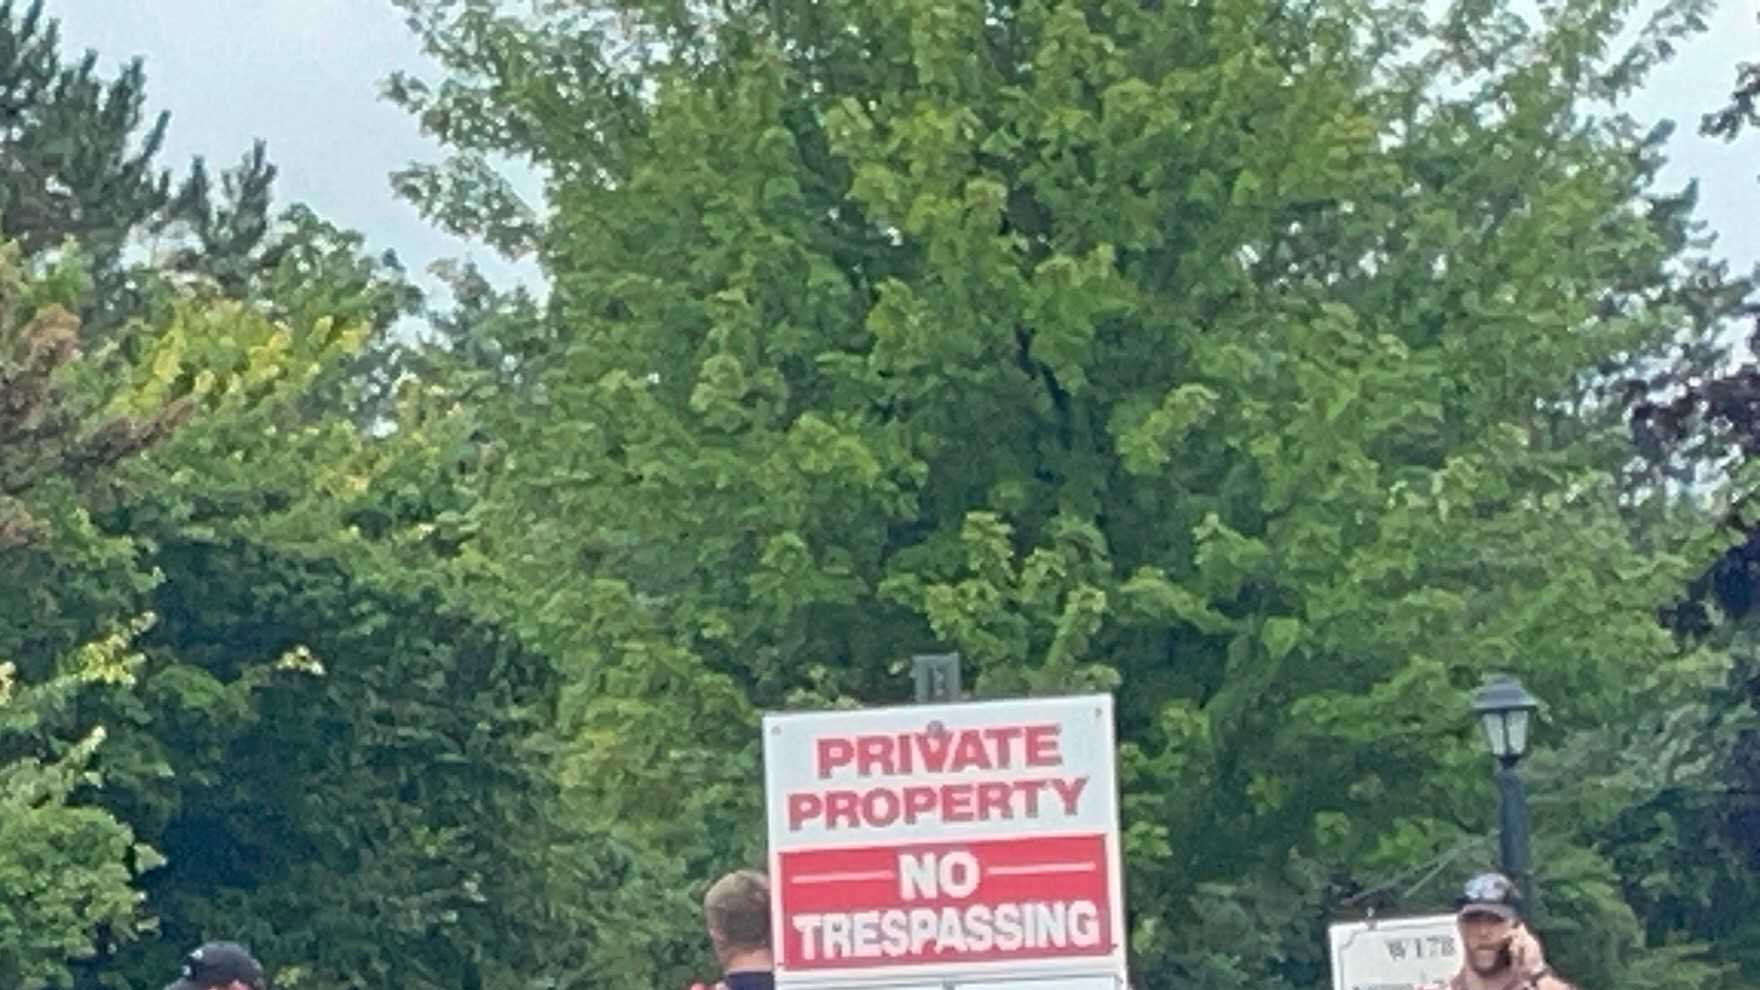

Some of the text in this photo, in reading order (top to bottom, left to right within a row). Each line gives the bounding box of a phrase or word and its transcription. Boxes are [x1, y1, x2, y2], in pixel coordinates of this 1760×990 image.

[817, 722, 1063, 779] PRIVATE
[788, 776, 1088, 831] PROPERTY
[898, 850, 980, 900] NO
[792, 900, 1101, 960] TRESPASSING
